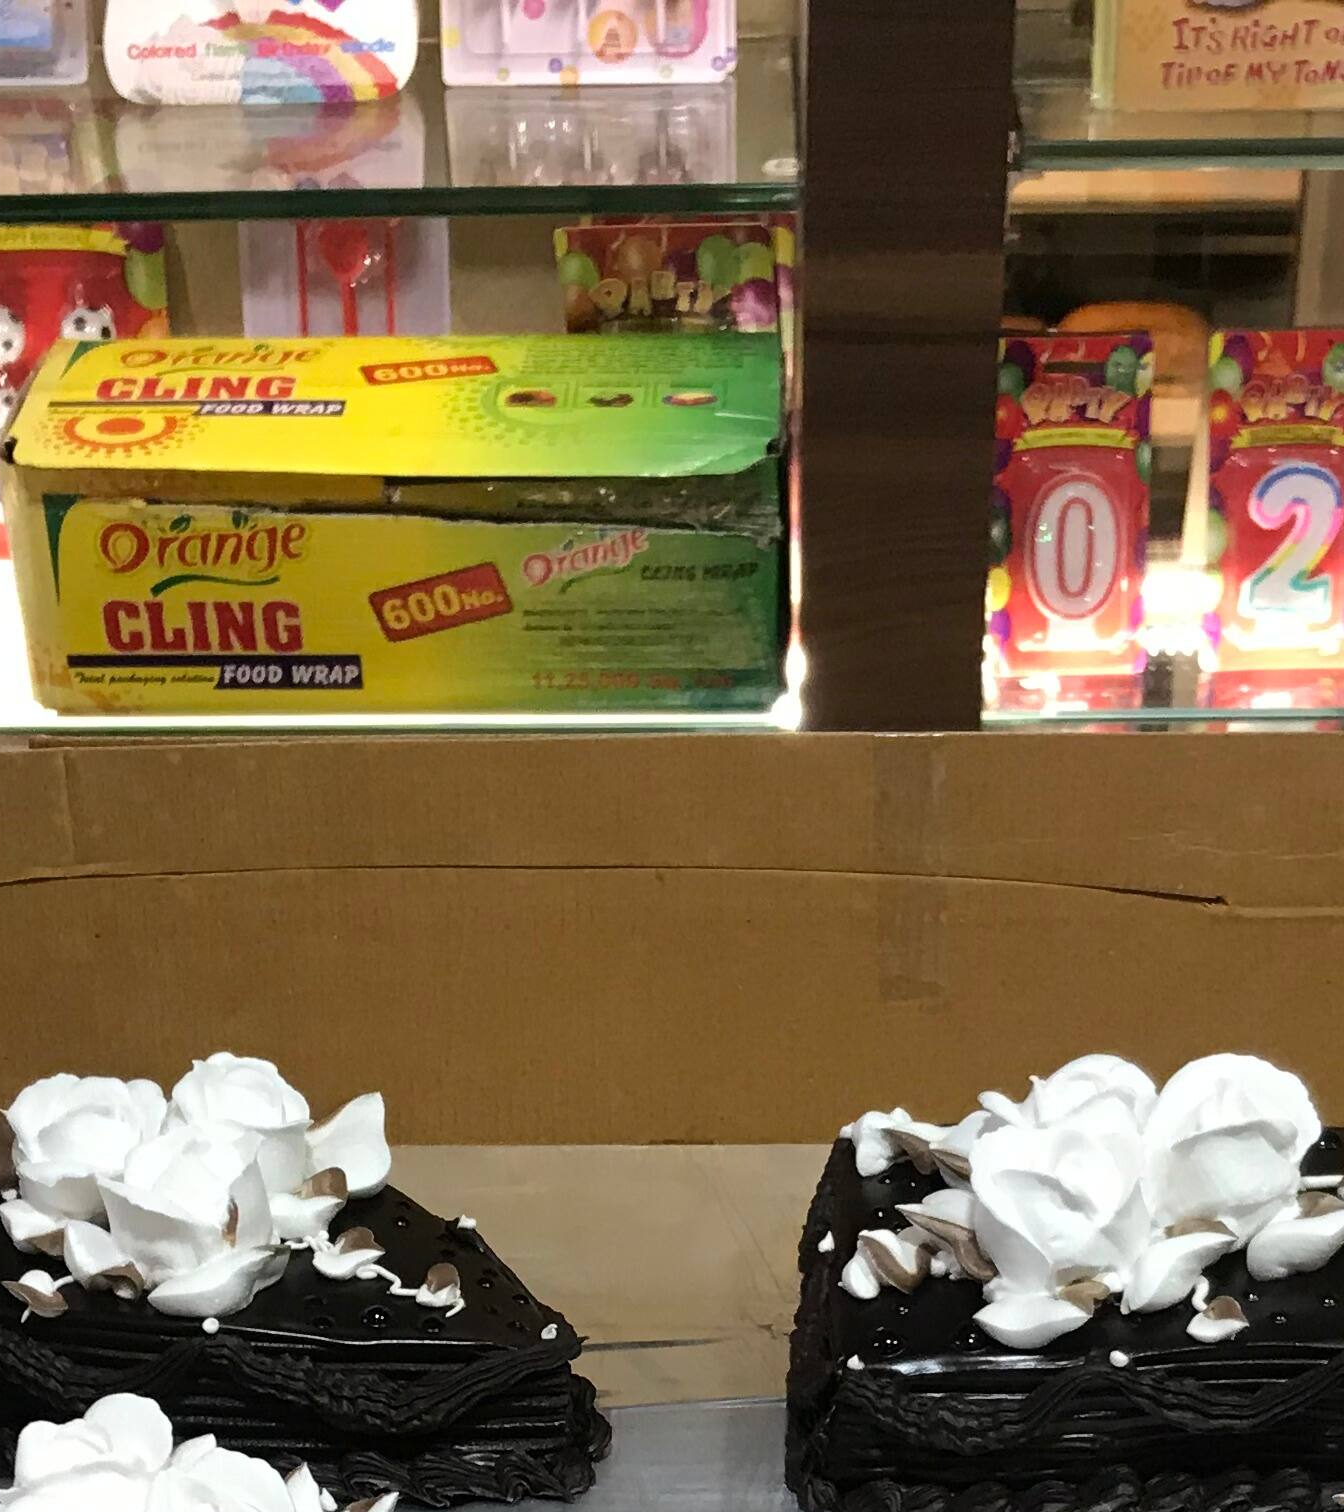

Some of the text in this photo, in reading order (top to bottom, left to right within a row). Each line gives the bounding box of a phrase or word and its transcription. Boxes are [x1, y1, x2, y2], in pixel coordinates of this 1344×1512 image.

[127, 42, 197, 60] Colored
[1246, 61, 1287, 84] MY
[373, 364, 449, 381] 600
[96, 376, 296, 401] CLING
[200, 403, 265, 415] FOOD
[272, 402, 343, 415] WRAP
[100, 518, 308, 575] Orange
[1028, 468, 1122, 620] 0
[523, 528, 648, 586] Orange
[382, 583, 461, 631] 600
[102, 600, 304, 653] CLING
[223, 663, 361, 685] FOOD WRAP
